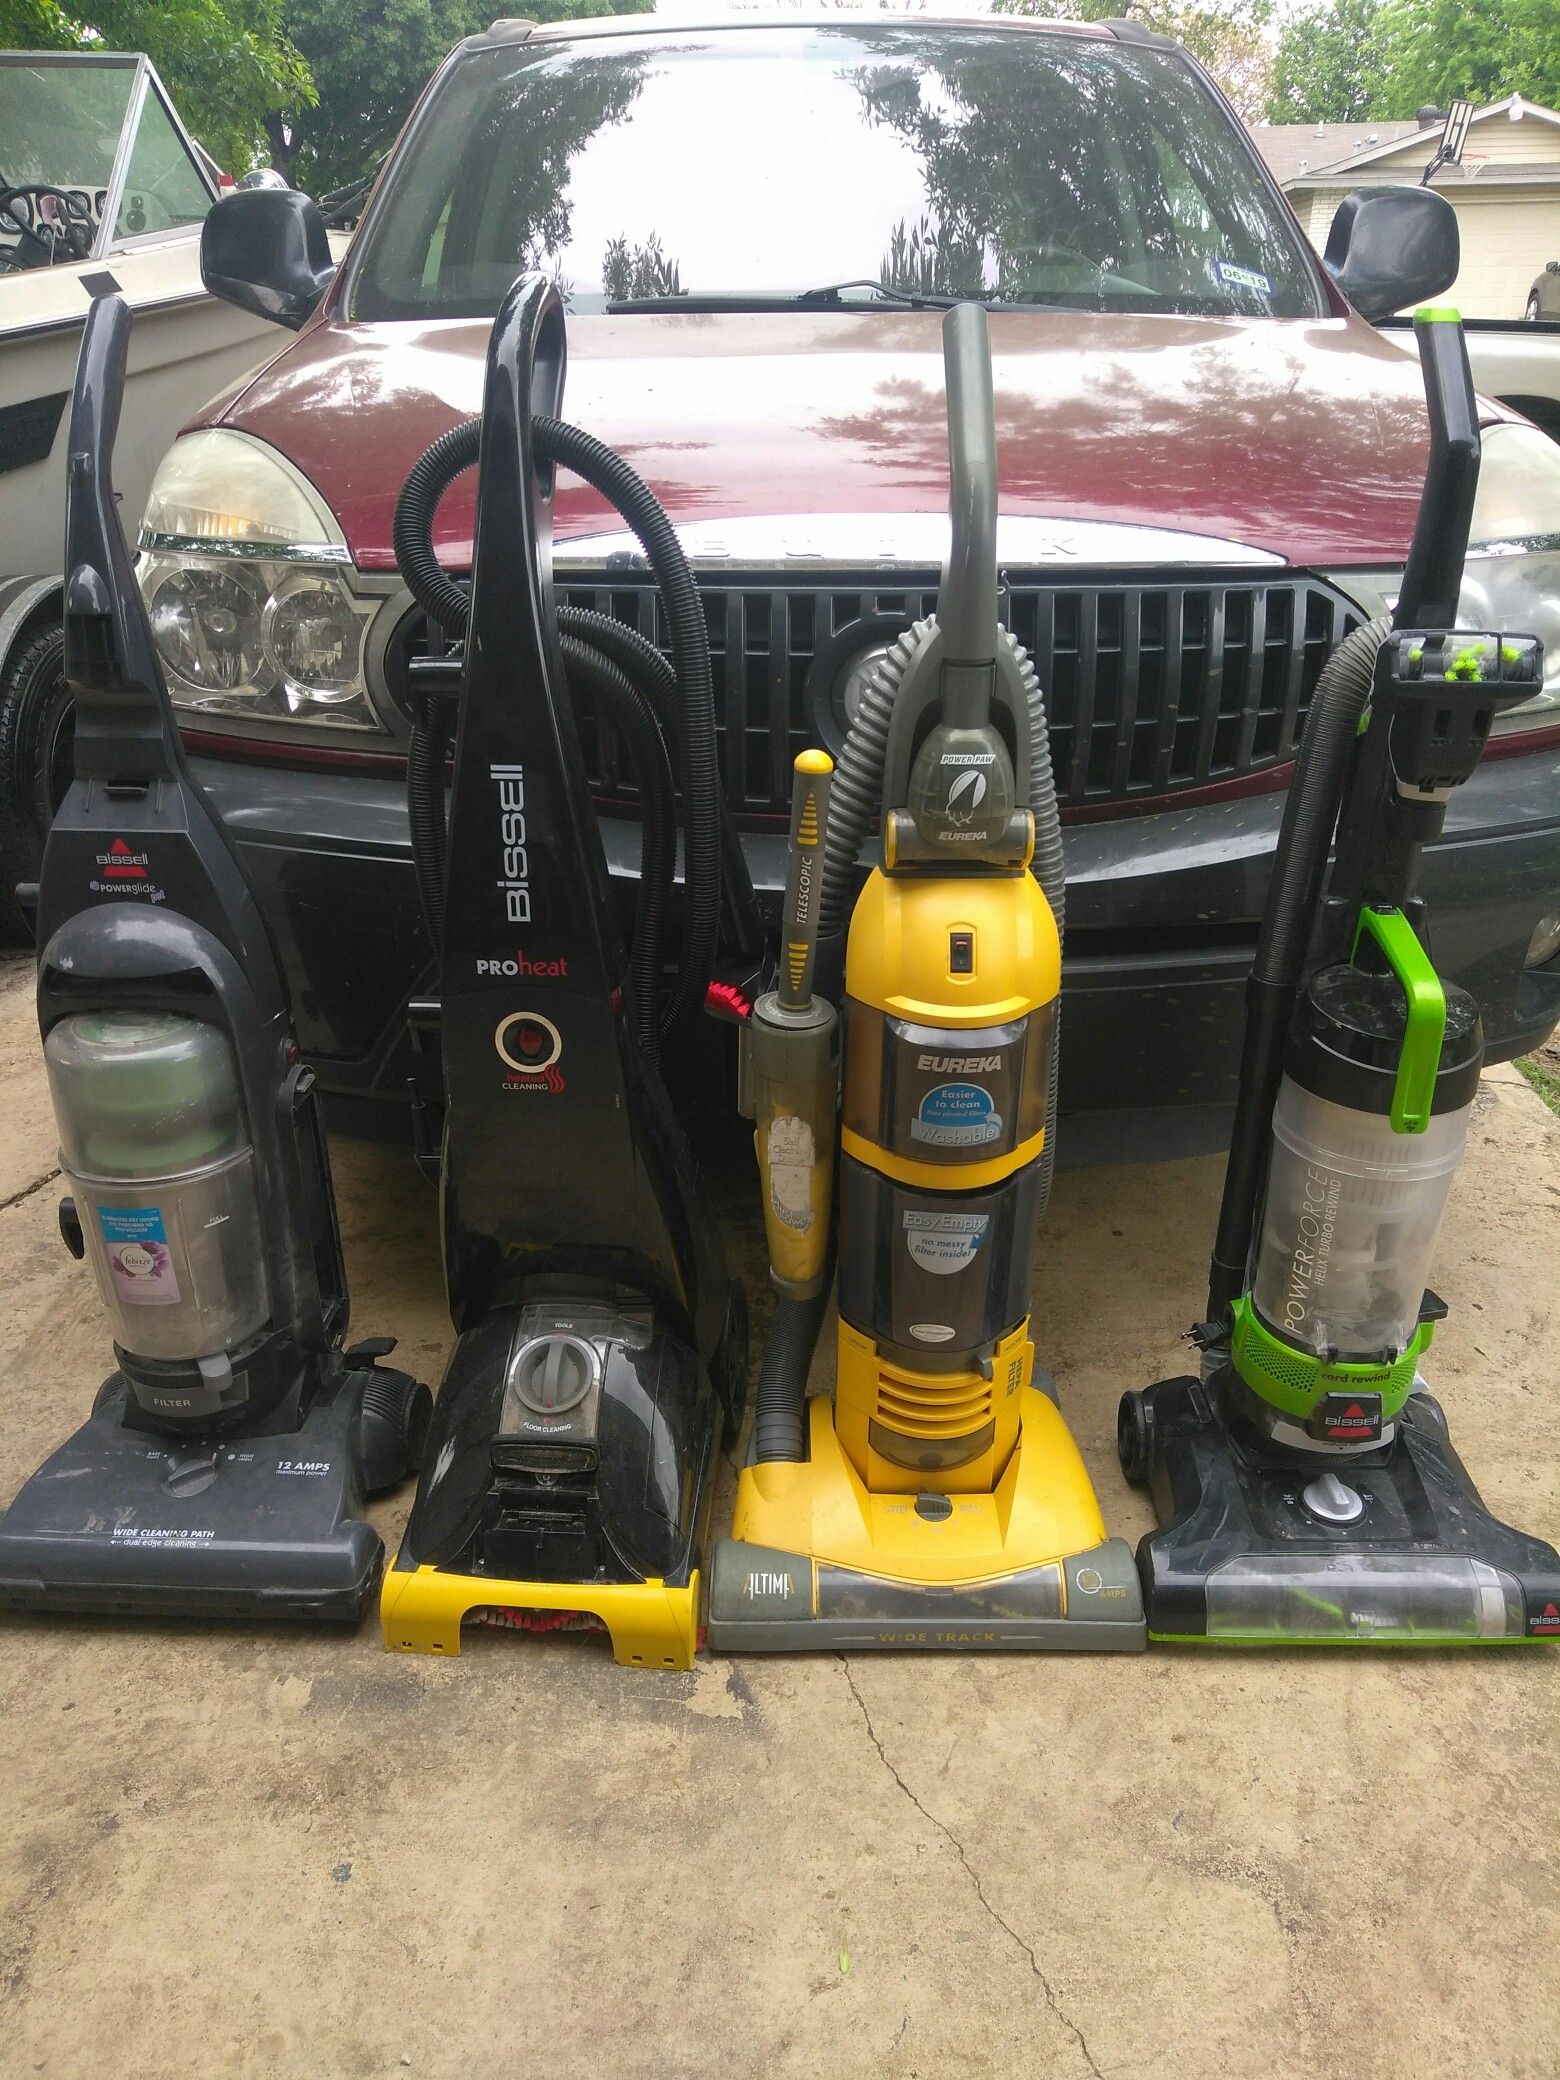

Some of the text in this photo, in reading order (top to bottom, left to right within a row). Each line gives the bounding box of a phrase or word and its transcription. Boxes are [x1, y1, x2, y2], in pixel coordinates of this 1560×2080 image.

[942, 754, 995, 764] POWER PAW
[939, 831, 987, 840] EUREKA
[796, 856, 813, 925] TELESCOPIC
[917, 1054, 1001, 1073] EUREKA
[502, 1082, 549, 1090] CLEANING
[942, 1090, 976, 1099] Easier
[951, 1100, 980, 1109] clean
[919, 1123, 994, 1145] Washable
[1325, 1179, 1342, 1222] REWIND
[905, 1213, 987, 1233] Easy Empty
[1318, 1223, 1334, 1255] TURBO
[937, 1240, 966, 1249] messy
[914, 1245, 971, 1258] filter inside!
[1321, 1371, 1390, 1383] cord rewind
[153, 1398, 192, 1407] FILTER
[522, 1421, 572, 1433] FLOOR CLEANING
[277, 1461, 331, 1471] 12 AMPS
[113, 1528, 215, 1538] WIDE CLEANING PATH
[142, 1539, 162, 1548] edge
[163, 1540, 197, 1548] cleaning
[879, 1632, 995, 1642] WDE TRACK
